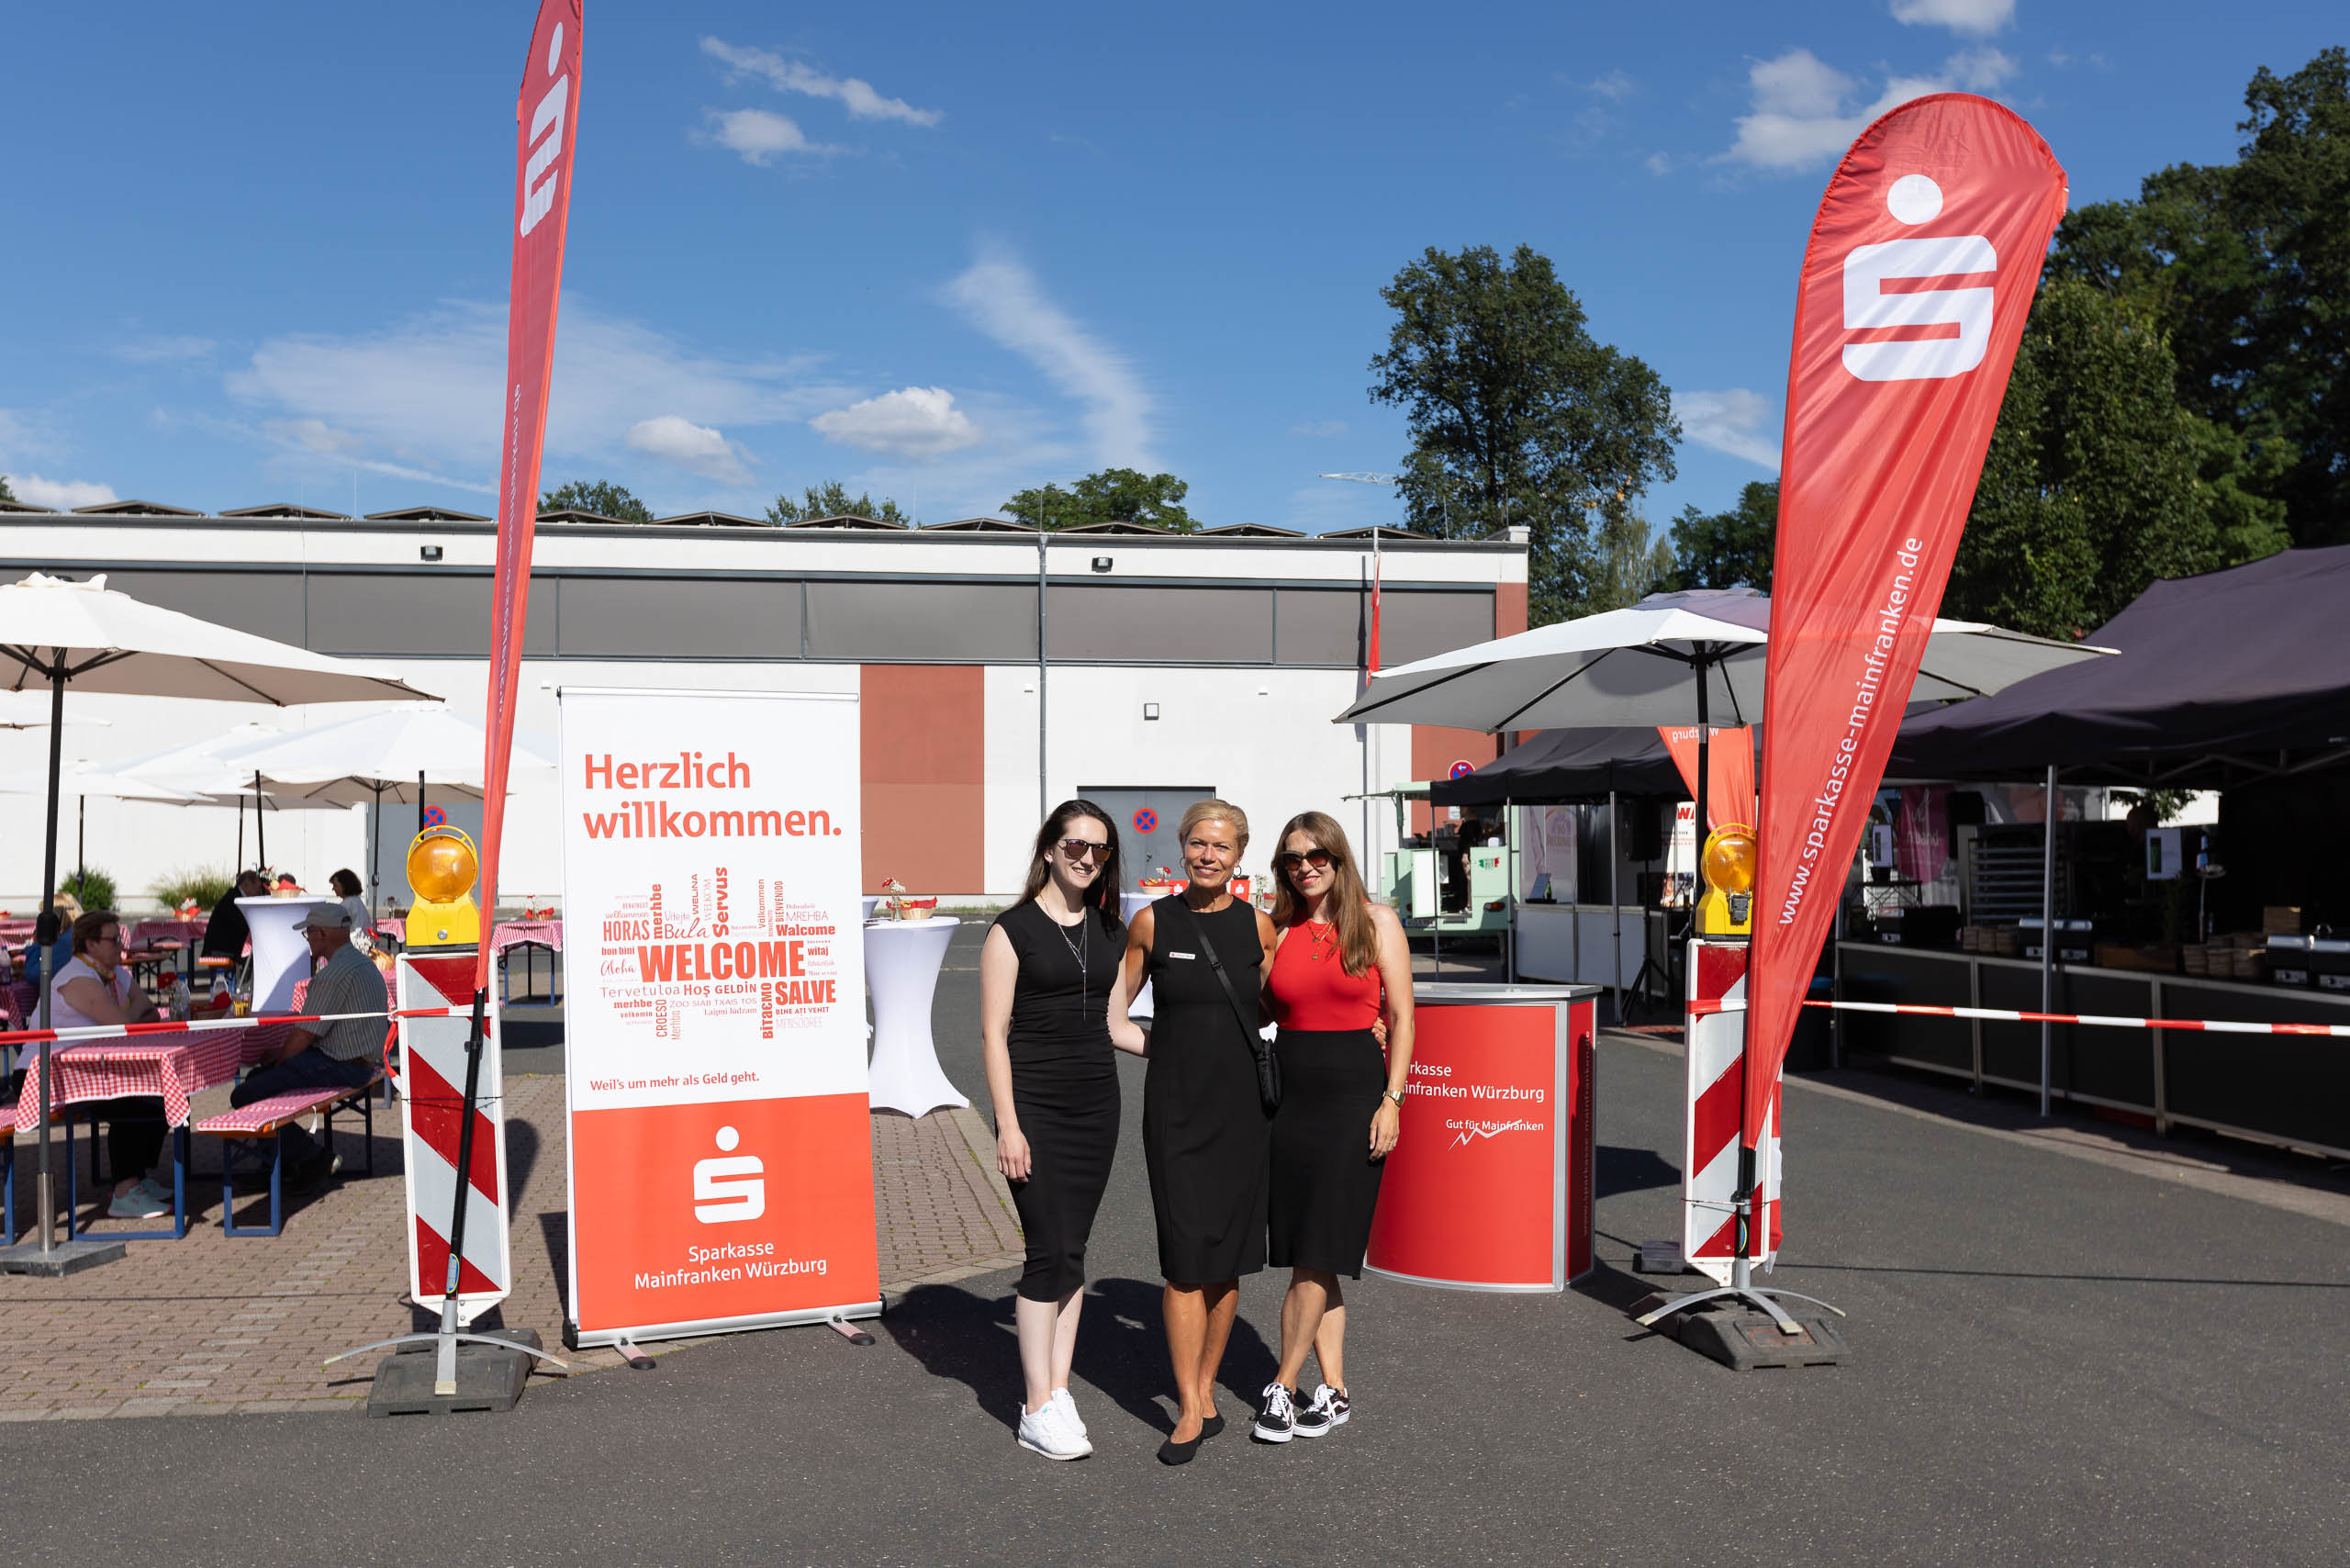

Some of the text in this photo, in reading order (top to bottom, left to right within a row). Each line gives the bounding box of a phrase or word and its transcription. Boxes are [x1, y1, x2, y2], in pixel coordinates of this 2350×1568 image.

[1779, 536, 1923, 925] www.sparkasse-mainfranken.de
[585, 752, 752, 790] Herzlich
[583, 801, 843, 839] willkommen.
[690, 873, 699, 915] WELINA
[712, 867, 729, 938] Servus
[757, 879, 766, 929] Välkommen
[774, 880, 785, 923] BIENVENIDO
[649, 883, 663, 940] merhbe
[602, 919, 650, 942] HORAS
[665, 916, 711, 939] Bula
[776, 924, 836, 936] Walcome
[601, 946, 618, 956] bon
[637, 939, 806, 983] WELCOME
[807, 946, 829, 957] witaj
[600, 958, 636, 977] Aloha
[600, 984, 680, 999] Tervetuloa
[613, 999, 653, 1009] merhbe
[669, 1000, 689, 1008] ZOO
[775, 979, 837, 1006] SALVE
[655, 999, 667, 1037] CROESO
[775, 1007, 793, 1015] BINE
[628, 1079, 647, 1090] um
[649, 1074, 680, 1089] mehr
[682, 1073, 699, 1086] als
[702, 1072, 728, 1085] Geld
[731, 1071, 760, 1087] geht.
[1409, 1060, 1452, 1078] rkasse
[1403, 1079, 1545, 1104] infranken Würzburg
[1445, 1118, 1545, 1132] Gut für Mainfranken
[688, 1240, 775, 1266] Sparkasse
[634, 1256, 828, 1290] Mainfranken Würzburg
